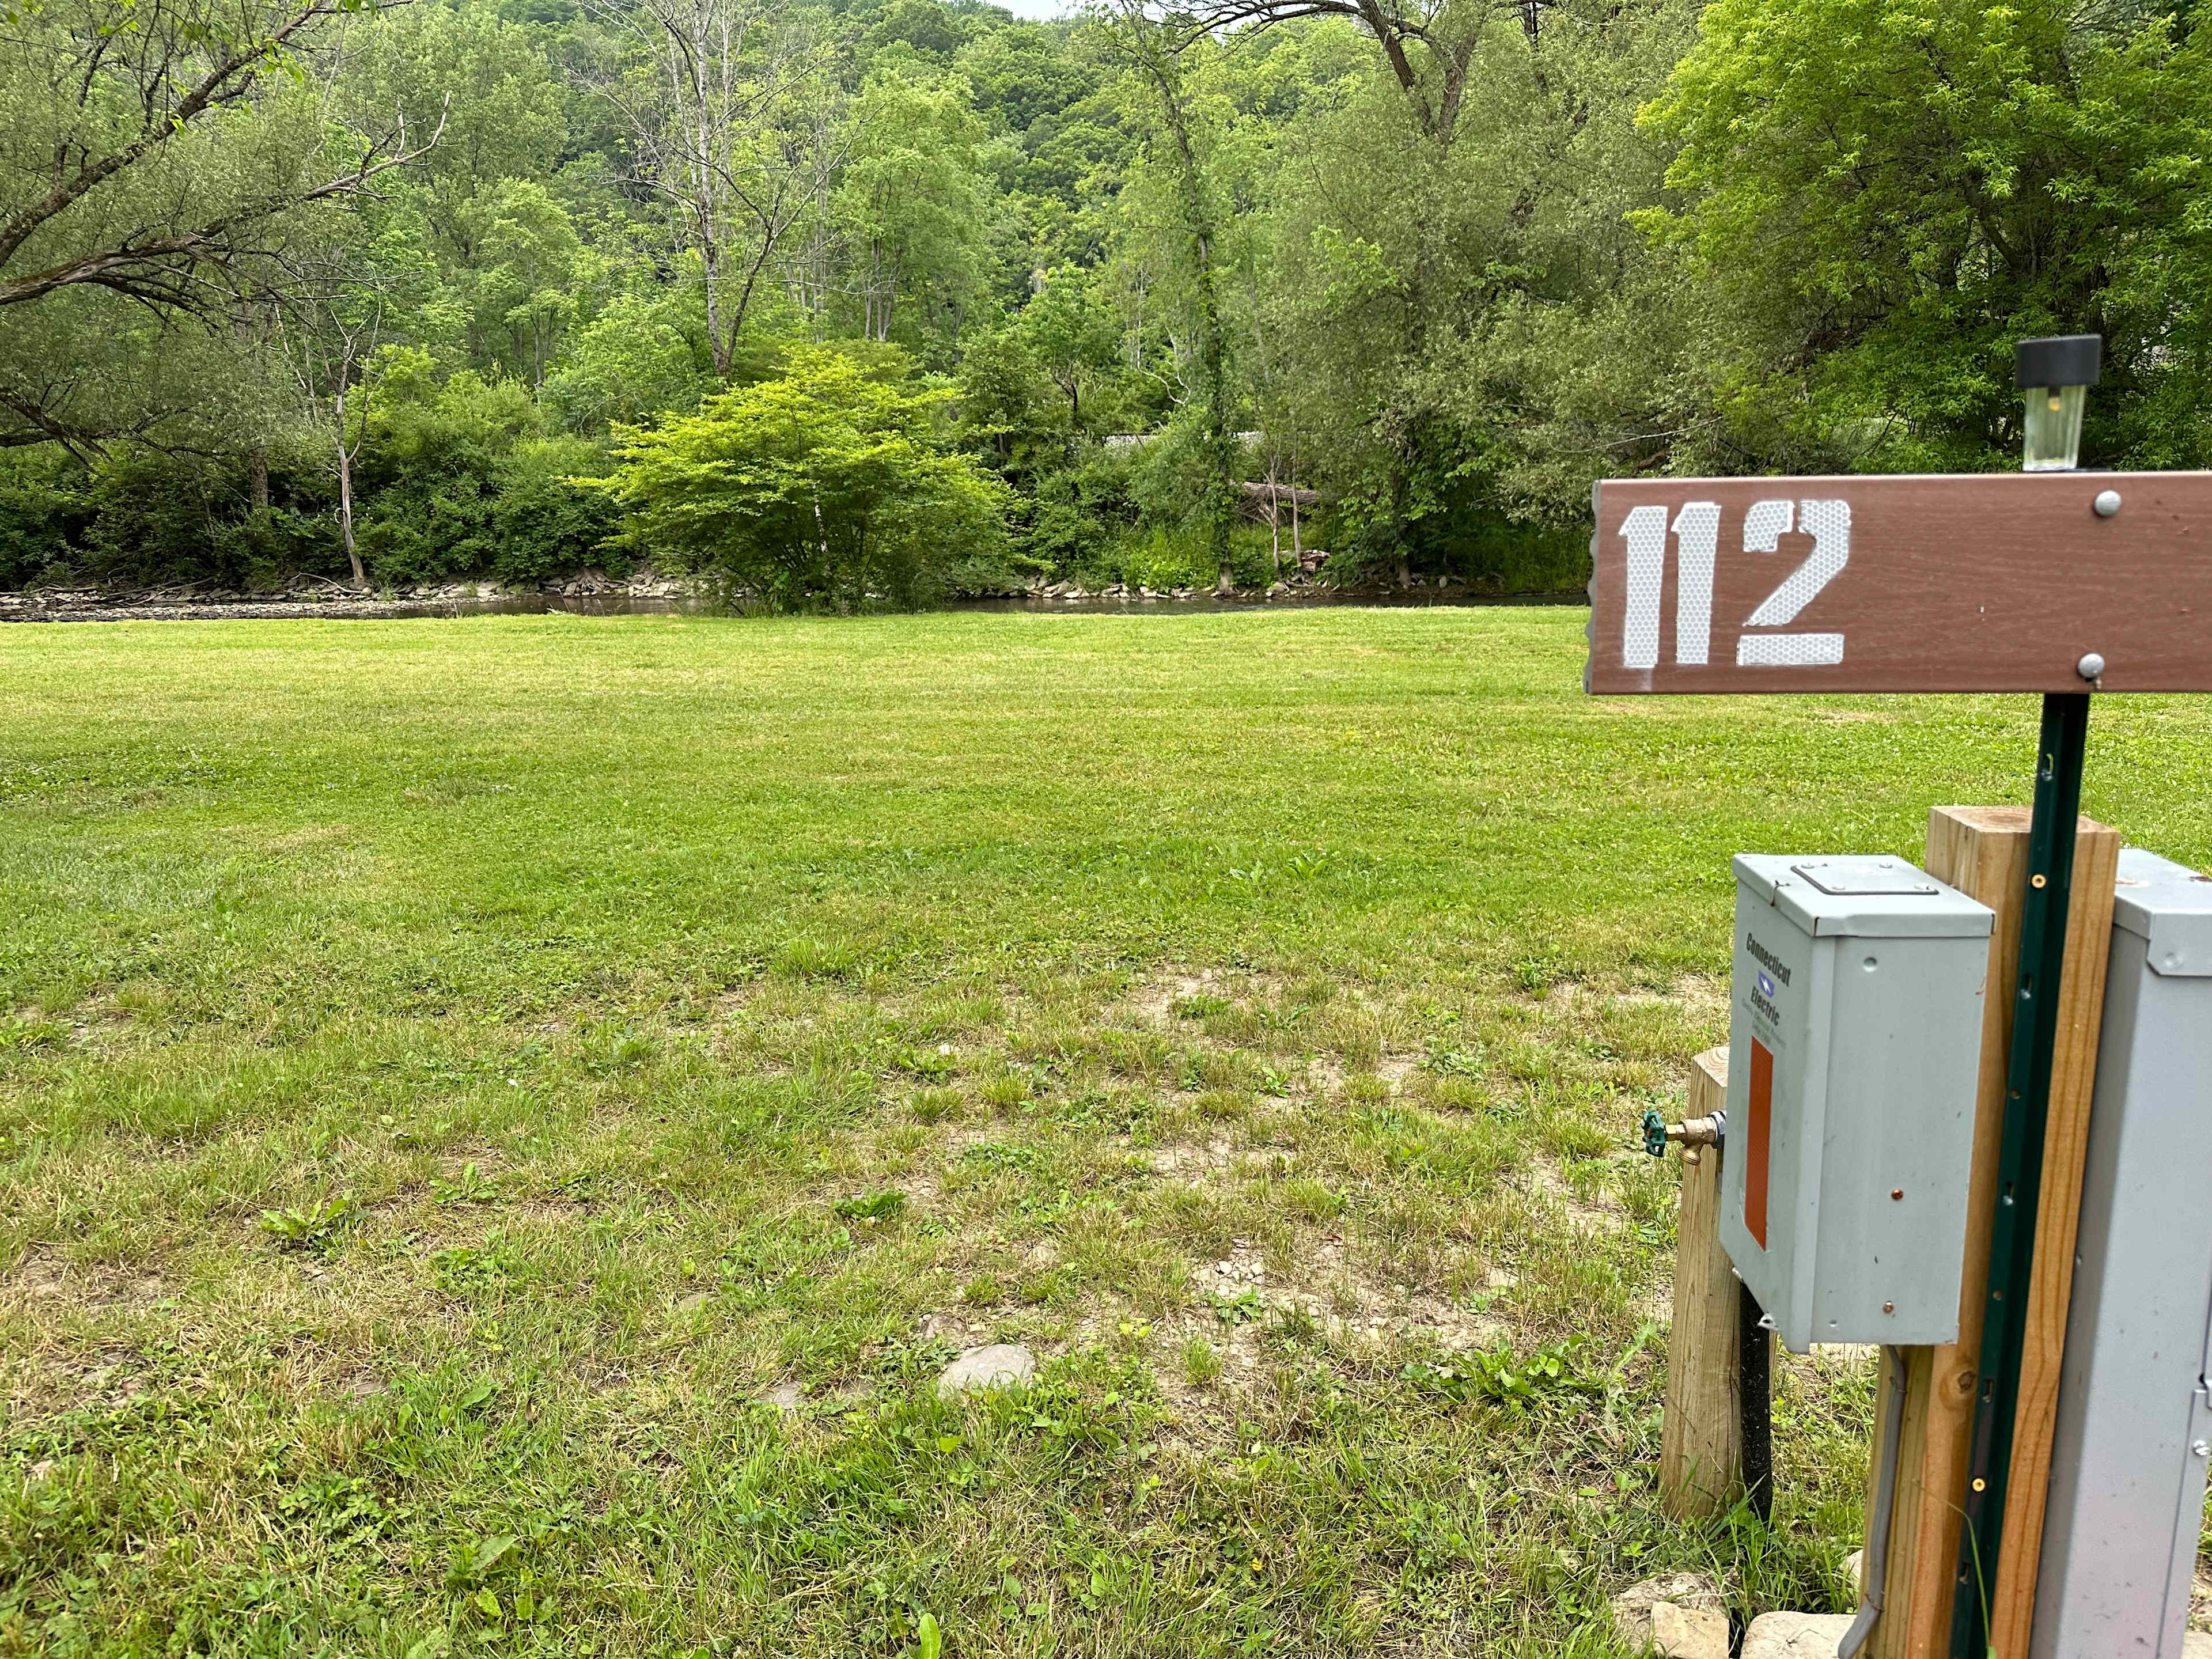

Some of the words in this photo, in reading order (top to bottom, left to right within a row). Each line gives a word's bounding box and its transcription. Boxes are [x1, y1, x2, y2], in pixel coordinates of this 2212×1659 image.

[1619, 500, 1851, 668] 112
[1746, 932, 1791, 986] Connecticut
[1751, 986, 1779, 1026] Electric
